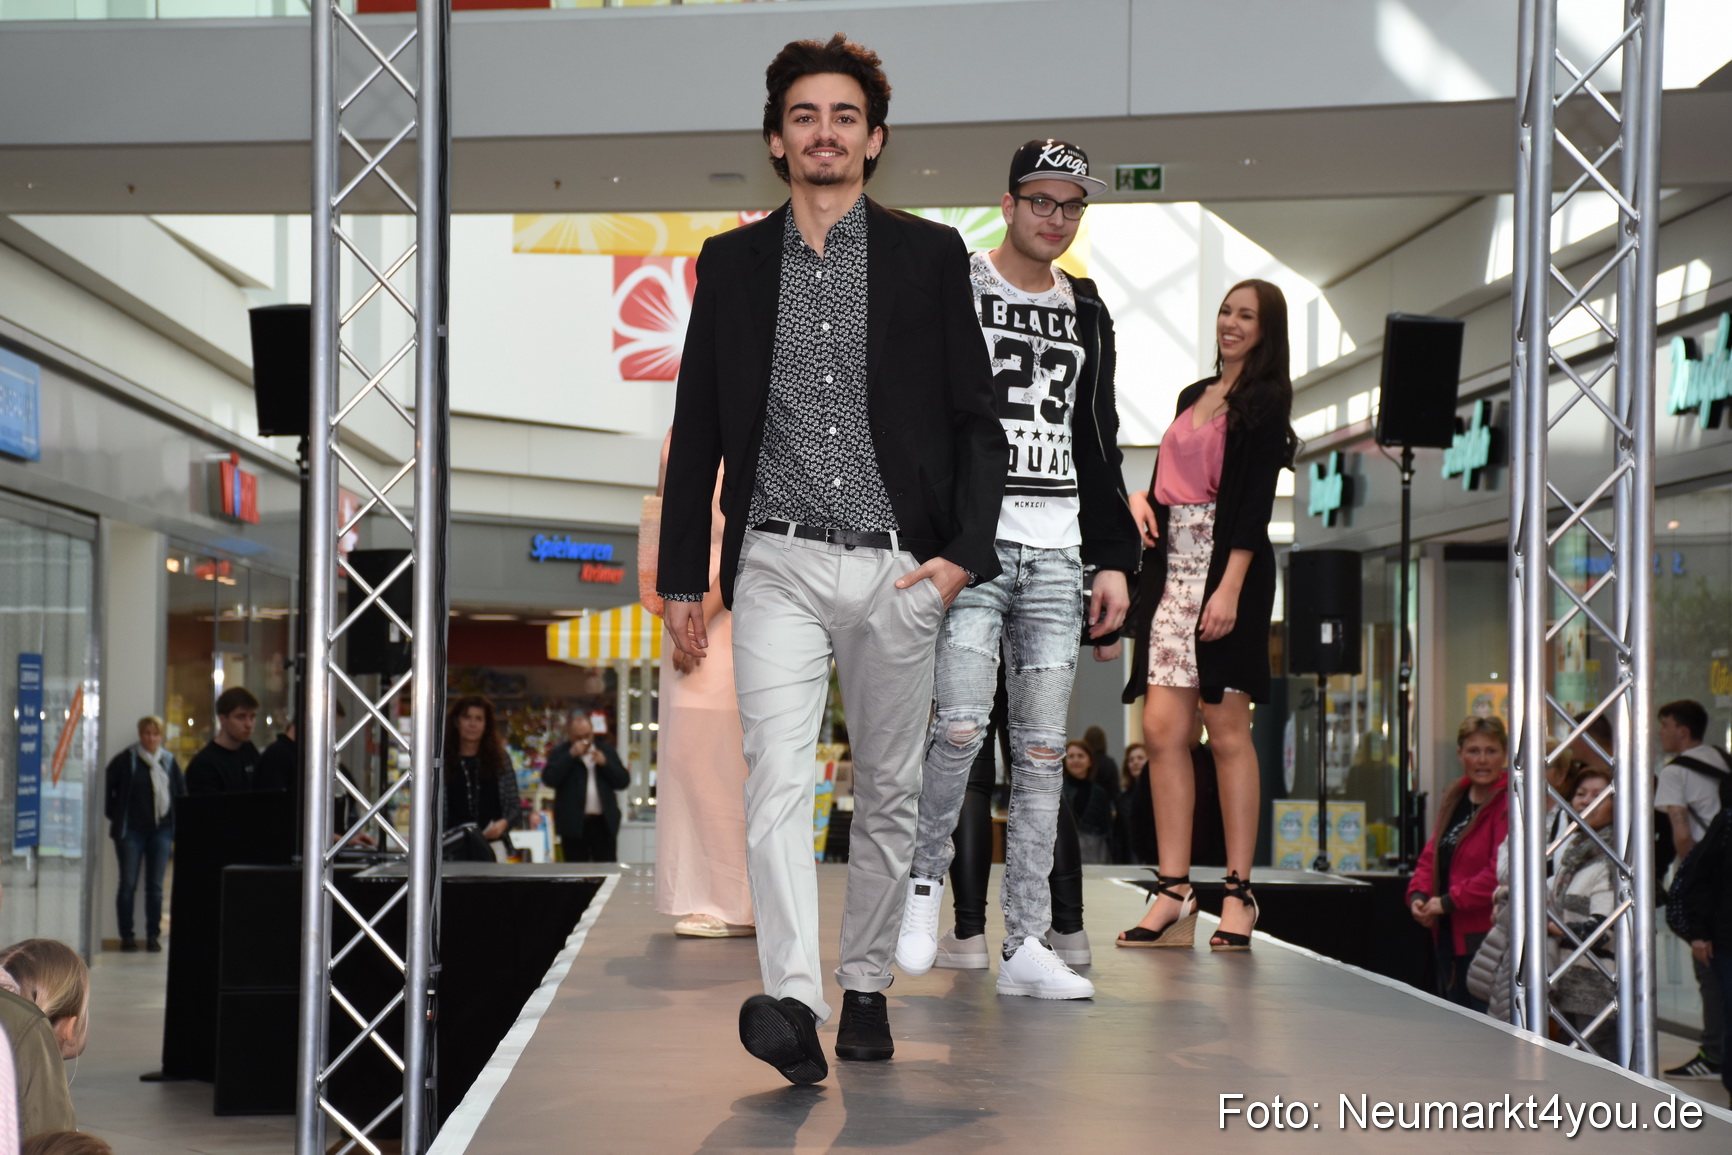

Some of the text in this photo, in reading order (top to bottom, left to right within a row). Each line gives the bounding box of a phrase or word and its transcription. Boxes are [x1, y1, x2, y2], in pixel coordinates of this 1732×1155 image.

[1035, 142, 1088, 176] Kings
[993, 300, 1078, 341] BLACK
[992, 336, 1077, 425] 23
[531, 533, 614, 562] Spielwaren
